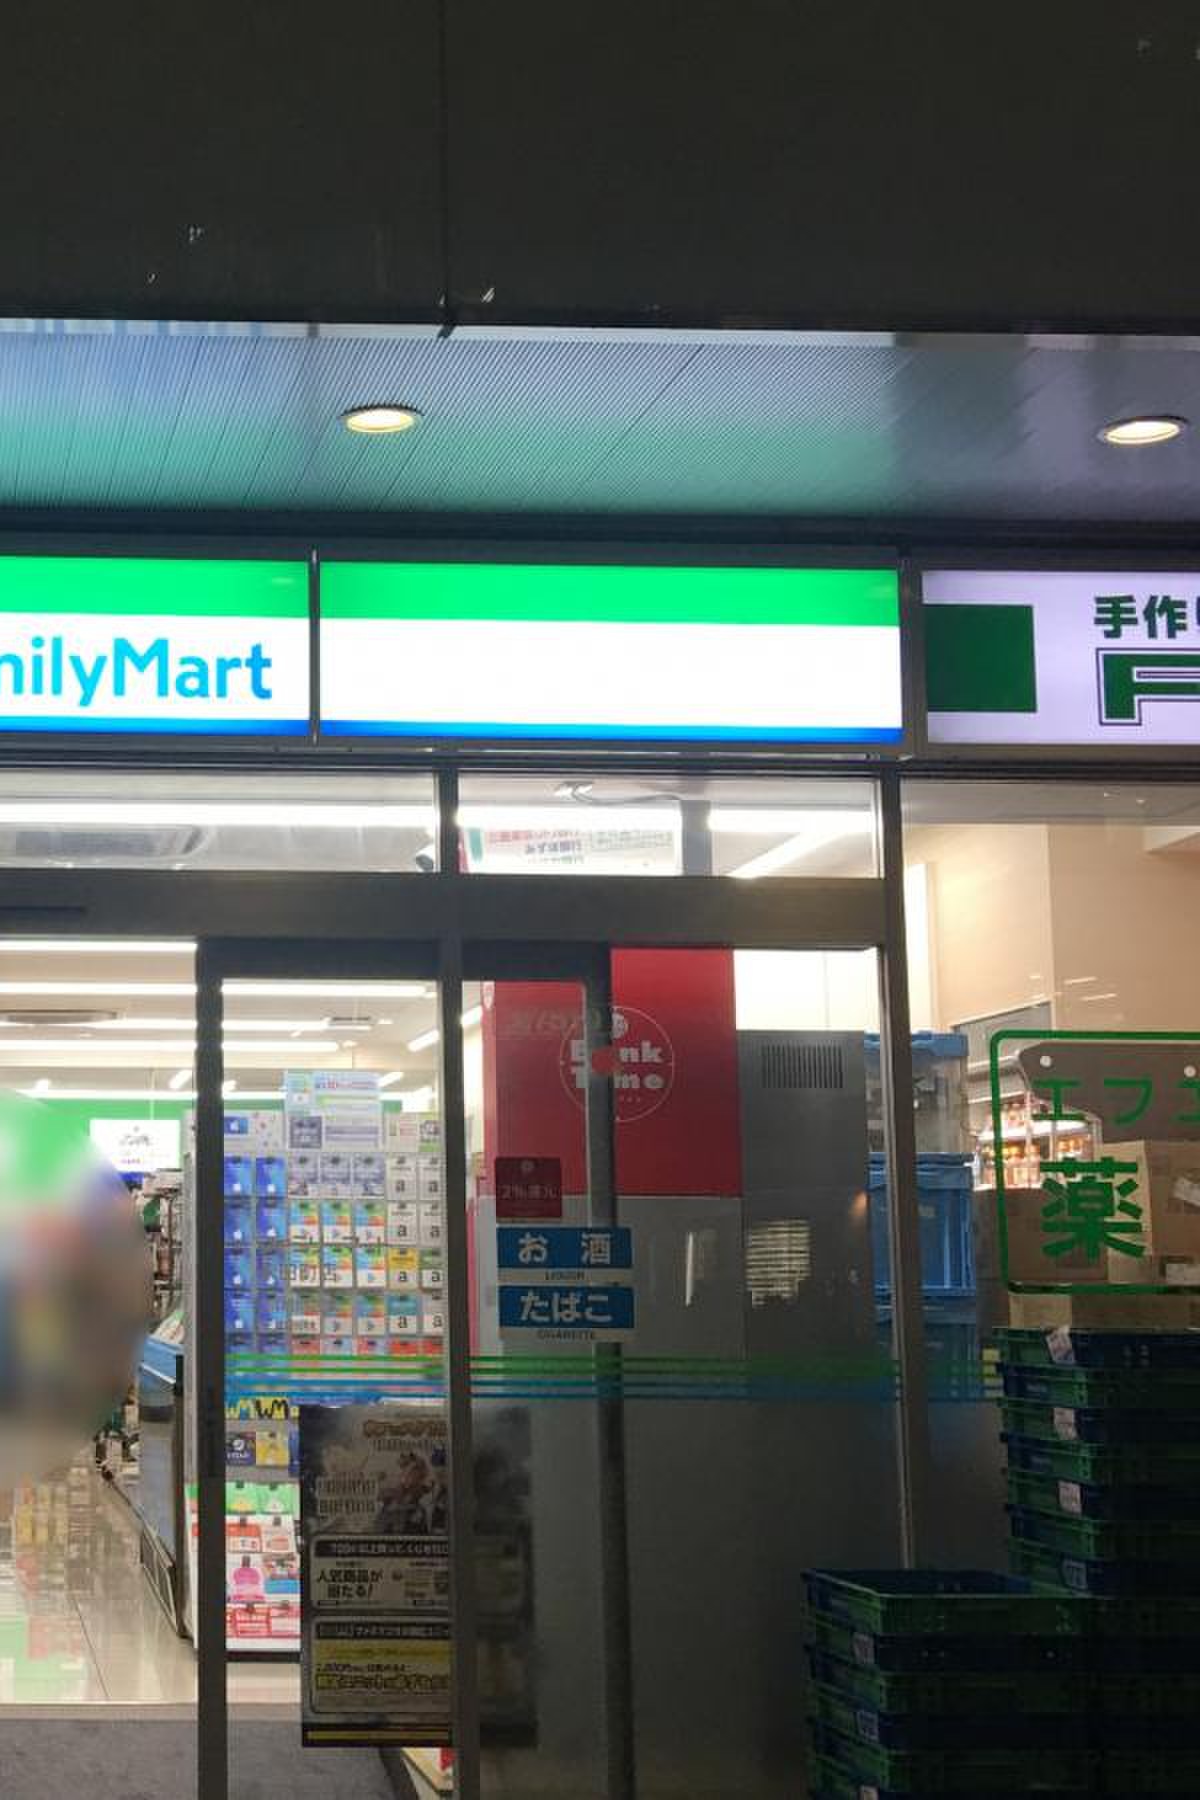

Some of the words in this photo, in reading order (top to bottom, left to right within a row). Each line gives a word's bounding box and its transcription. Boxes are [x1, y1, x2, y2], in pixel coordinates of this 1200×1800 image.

[1093, 594, 1200, 639] 手作
[571, 1066, 665, 1089] Tme
[1039, 1156, 1146, 1264] 薬
[520, 1290, 612, 1323] たばこ
